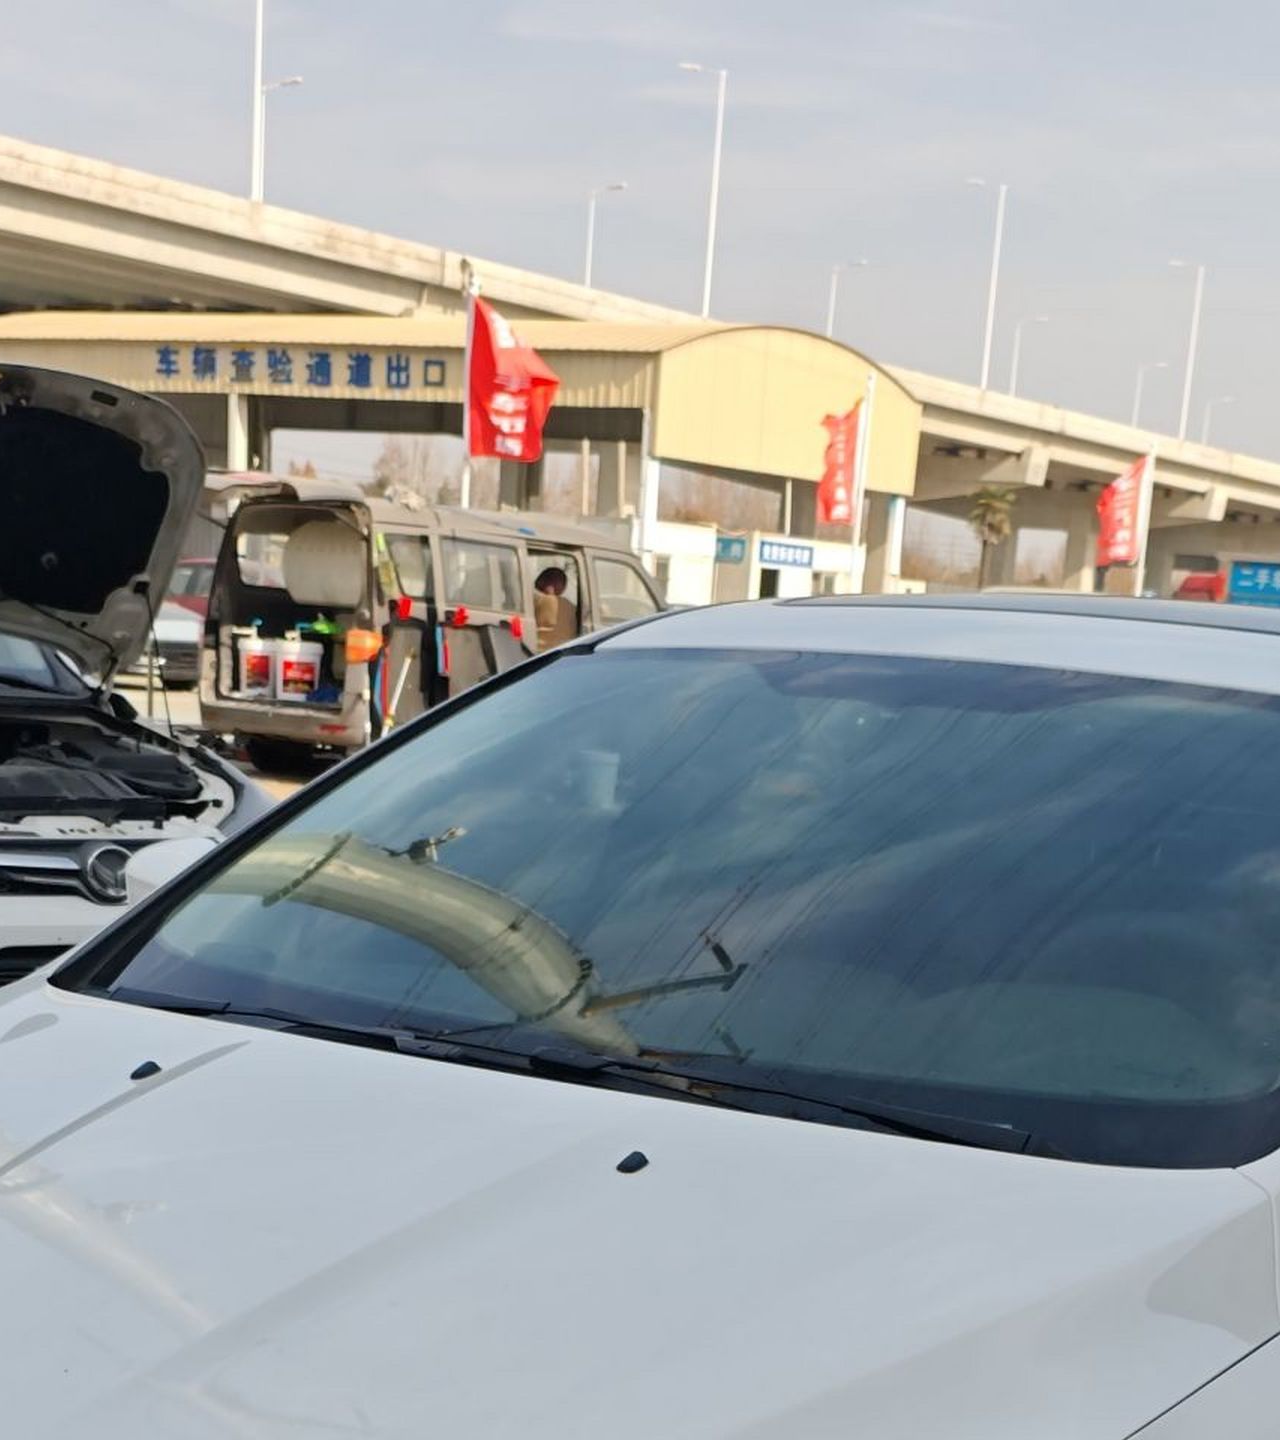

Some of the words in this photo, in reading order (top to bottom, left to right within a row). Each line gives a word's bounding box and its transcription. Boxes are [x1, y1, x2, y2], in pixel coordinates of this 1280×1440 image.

[155, 345, 446, 388] 车辆查验通道出口
